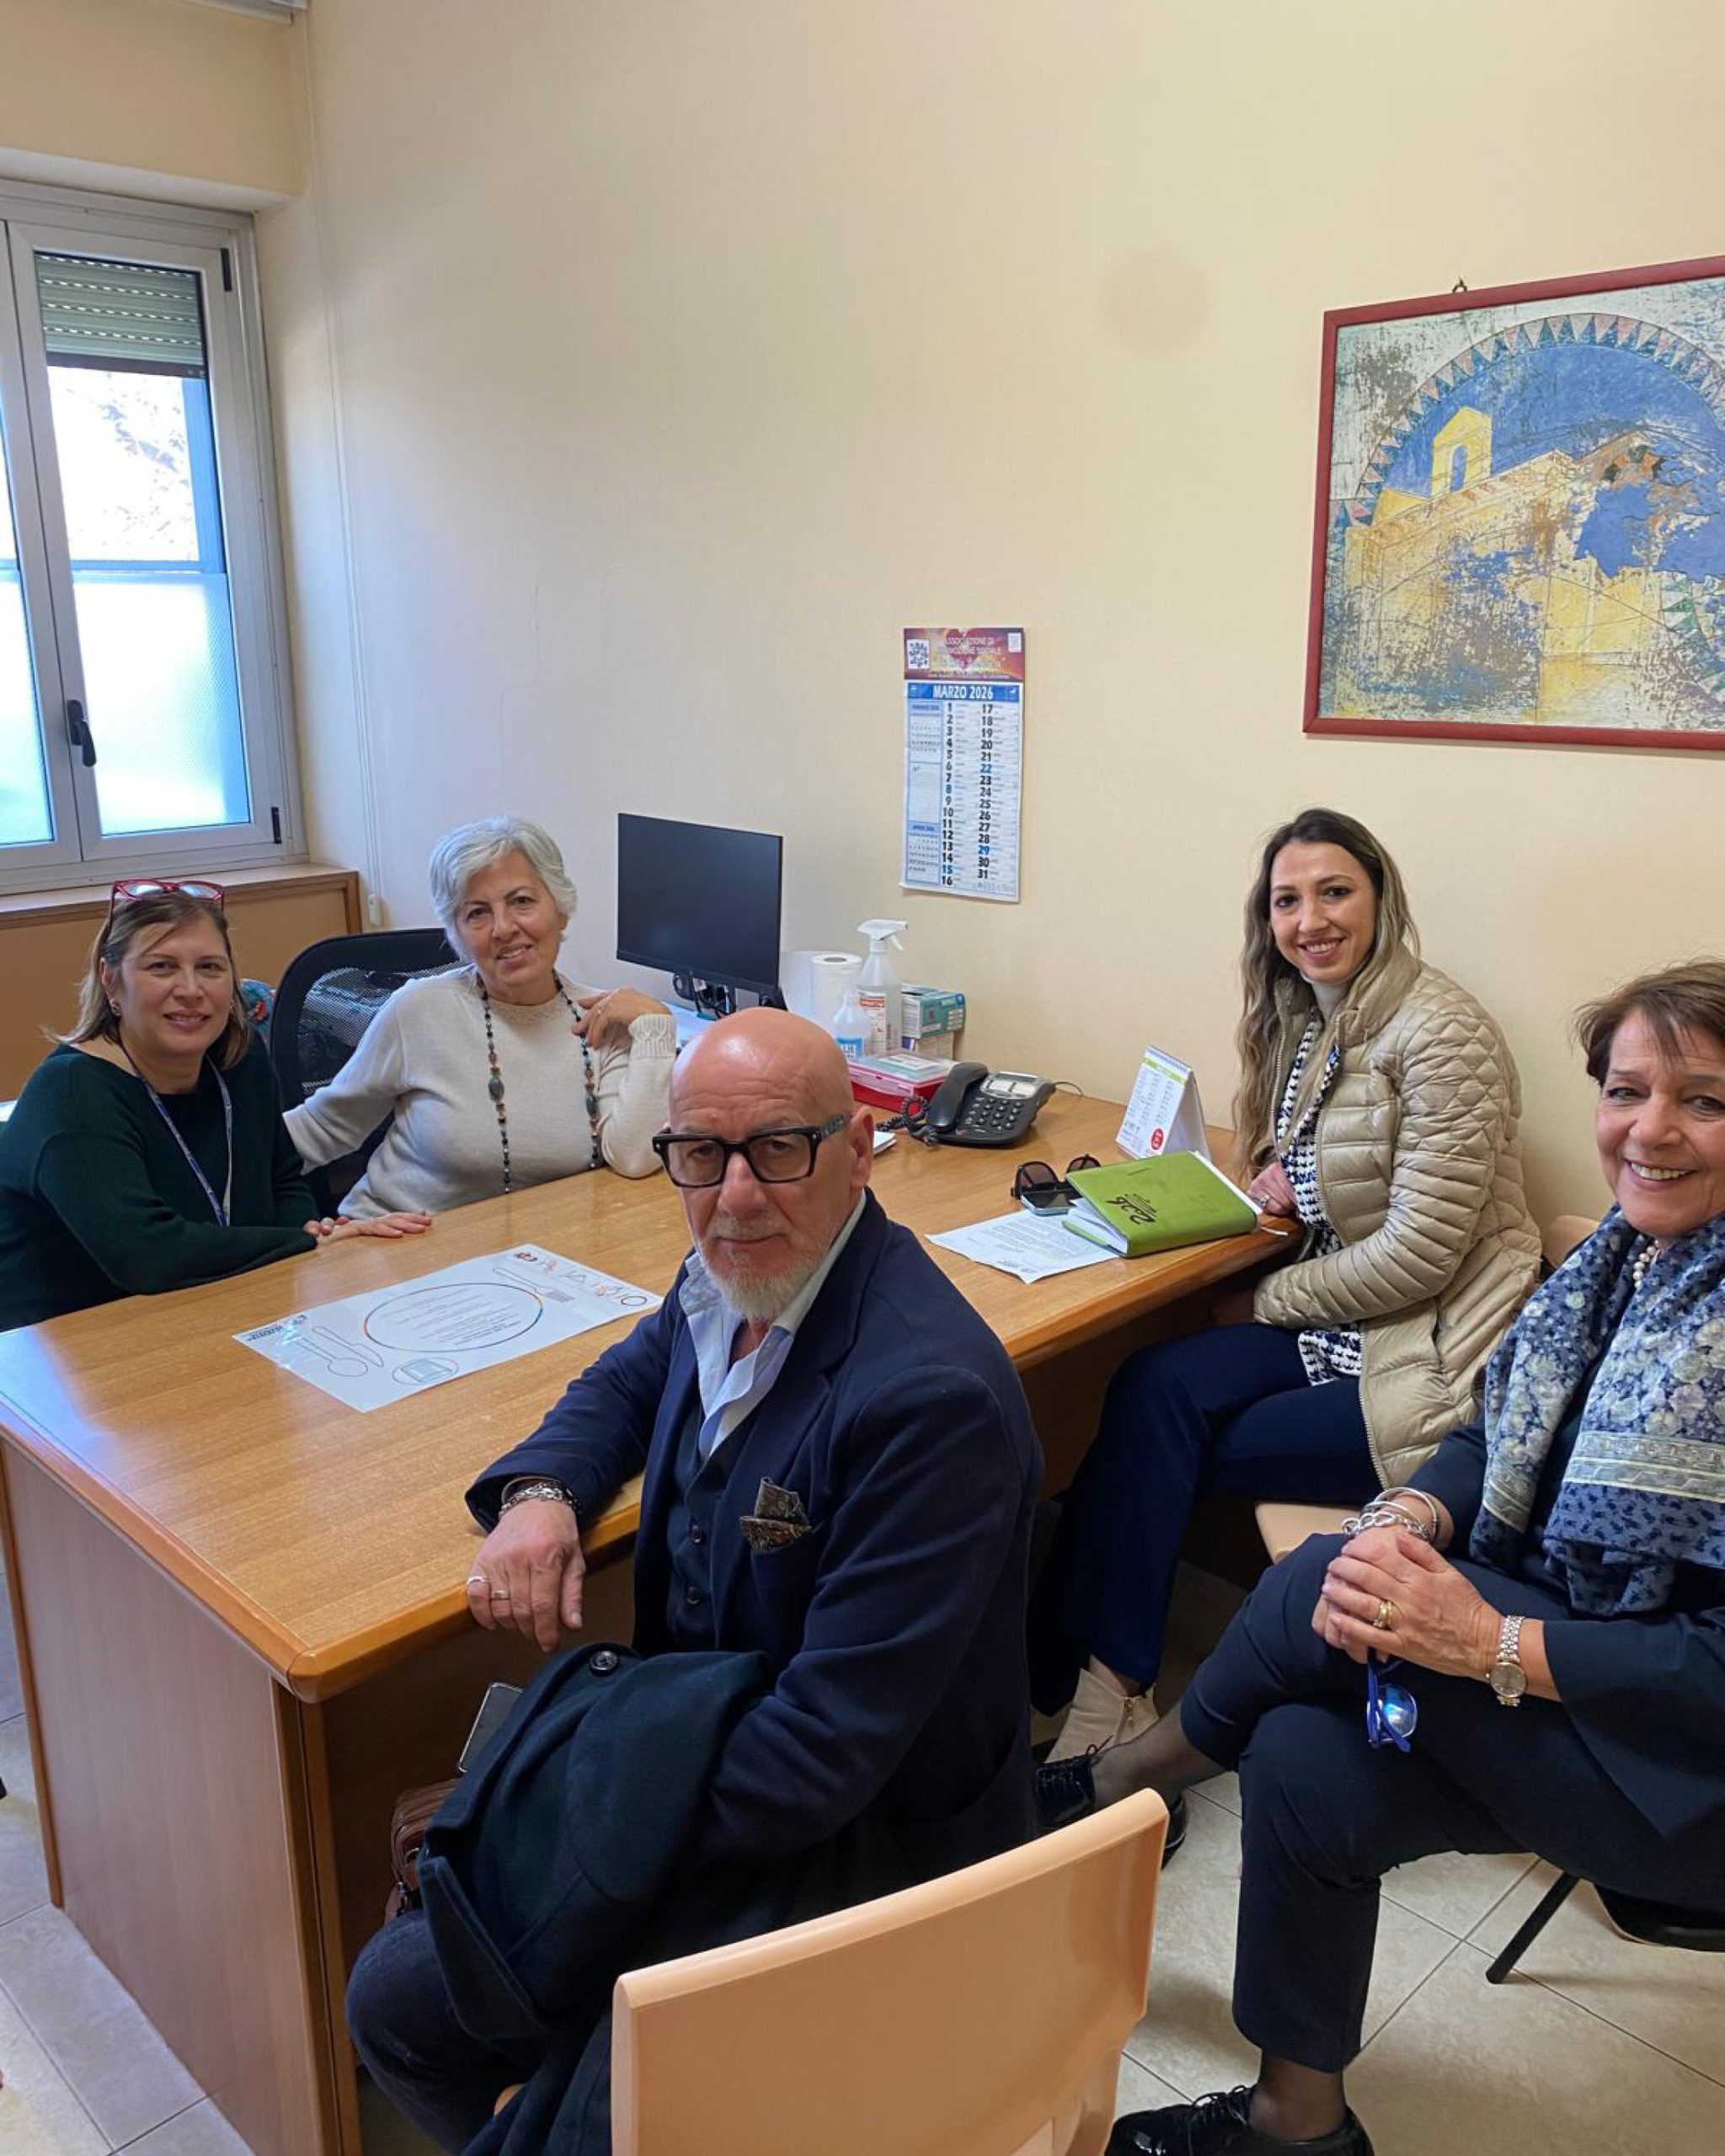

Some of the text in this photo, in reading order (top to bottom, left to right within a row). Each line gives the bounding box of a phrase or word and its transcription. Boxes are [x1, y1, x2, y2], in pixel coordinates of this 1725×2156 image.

[932, 685, 993, 700] MARZO 2026
[982, 704, 993, 713] 17
[947, 714, 953, 723] 2
[981, 716, 993, 726] 18
[947, 726, 953, 736] 3
[981, 728, 992, 738] 19
[946, 738, 953, 747] 4
[980, 739, 992, 750] 20
[947, 750, 953, 759] 5
[980, 751, 991, 761] 21
[946, 761, 952, 771] 6
[980, 763, 991, 773] 22
[946, 772, 952, 782] 7
[980, 775, 991, 785] 23
[946, 784, 952, 793] 8
[980, 787, 991, 797] 24
[946, 796, 952, 805] 9
[980, 798, 991, 808] 25
[943, 808, 953, 817] 10
[979, 810, 991, 820] 26
[943, 819, 953, 829] 11
[979, 822, 990, 832] 27
[943, 830, 953, 840] 12
[979, 834, 990, 844] 28
[943, 841, 953, 851] 13
[978, 845, 990, 855] 29
[943, 853, 953, 863] 14
[978, 857, 990, 867] 30
[943, 864, 953, 874] 15
[977, 868, 988, 878] 31
[942, 876, 953, 885] 16
